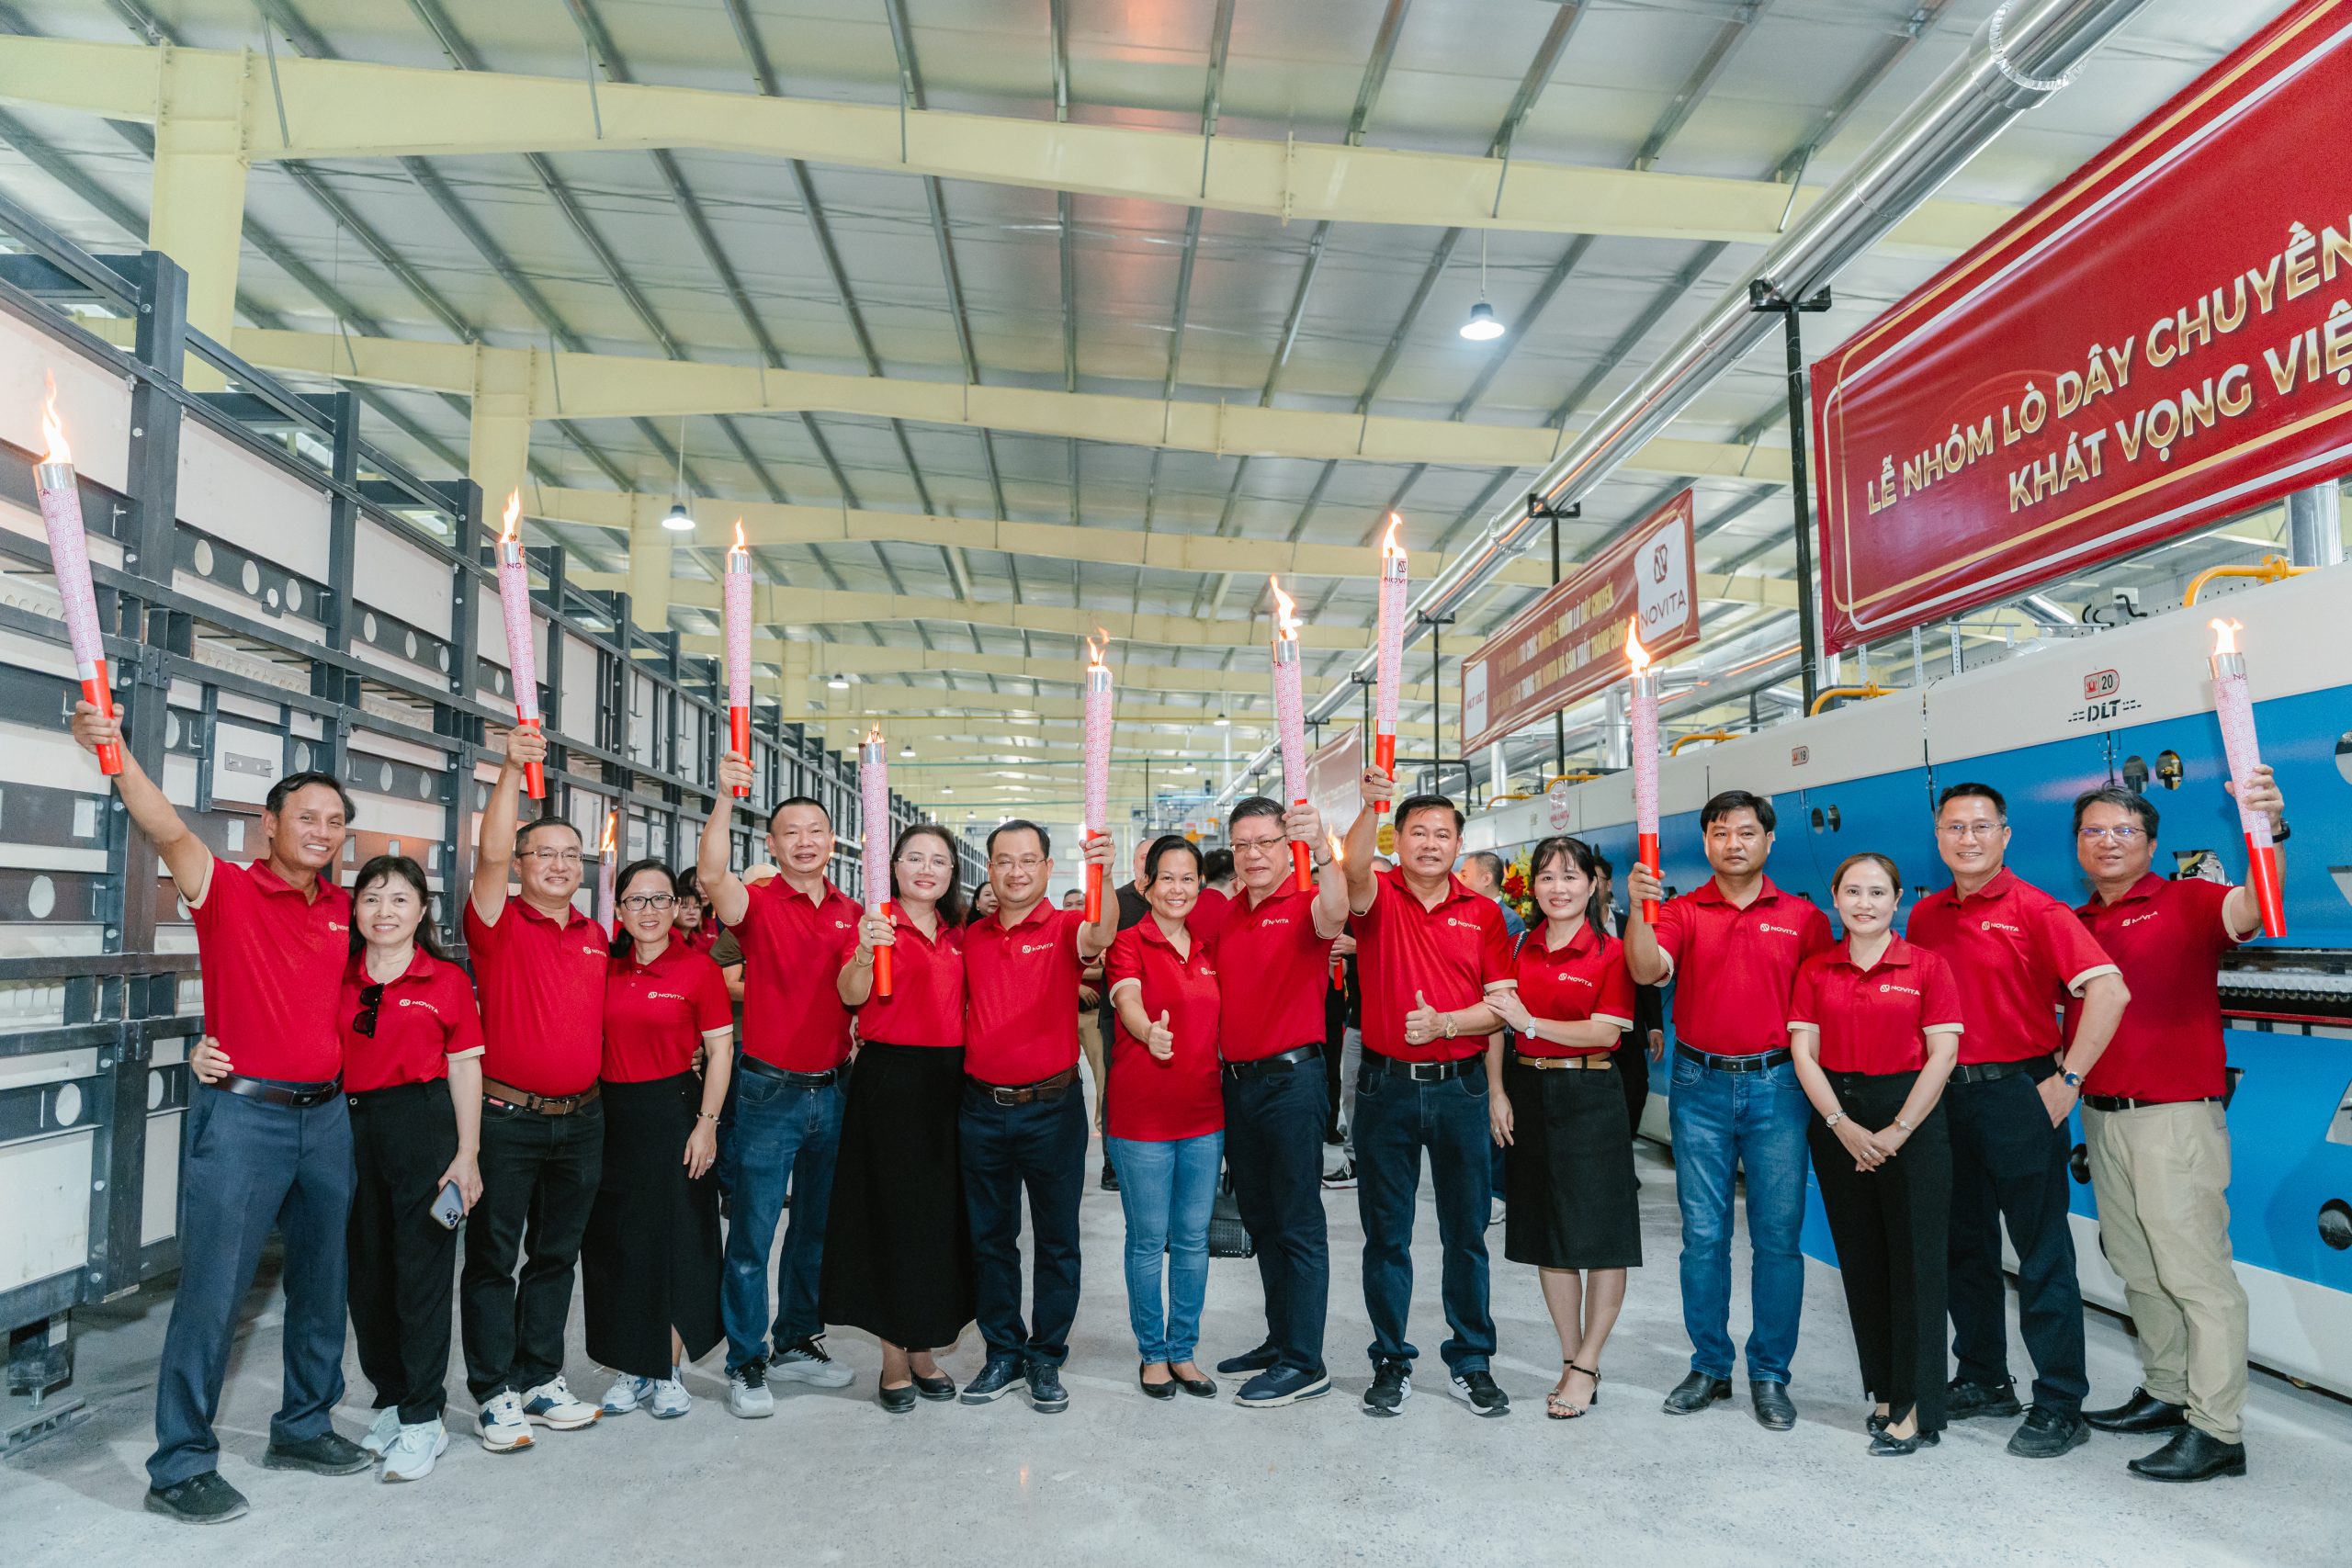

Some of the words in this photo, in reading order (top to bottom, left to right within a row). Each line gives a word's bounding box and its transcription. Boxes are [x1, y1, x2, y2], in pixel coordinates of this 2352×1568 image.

[1868, 455, 1896, 514] LỄ
[1903, 423, 1994, 497] NHÓM
[2002, 380, 2047, 446] LÒ
[2056, 335, 2135, 418] DÂY
[2009, 432, 2107, 513] KHÁT
[2115, 363, 2252, 461] VỌNG
[1640, 589, 1687, 630] NOVITA
[2101, 674, 2113, 691] 20
[2086, 699, 2121, 722] DLT
[1457, 919, 1482, 931] NOVITA
[1771, 925, 1798, 936] NOVITA
[1990, 922, 2019, 932] NOVITA
[1032, 942, 1054, 952] NOVITA
[1567, 975, 1593, 987] NOVITA
[657, 992, 685, 1000] NOVITA
[1891, 985, 1920, 996] NOVITA
[411, 999, 439, 1014] NOVITA
